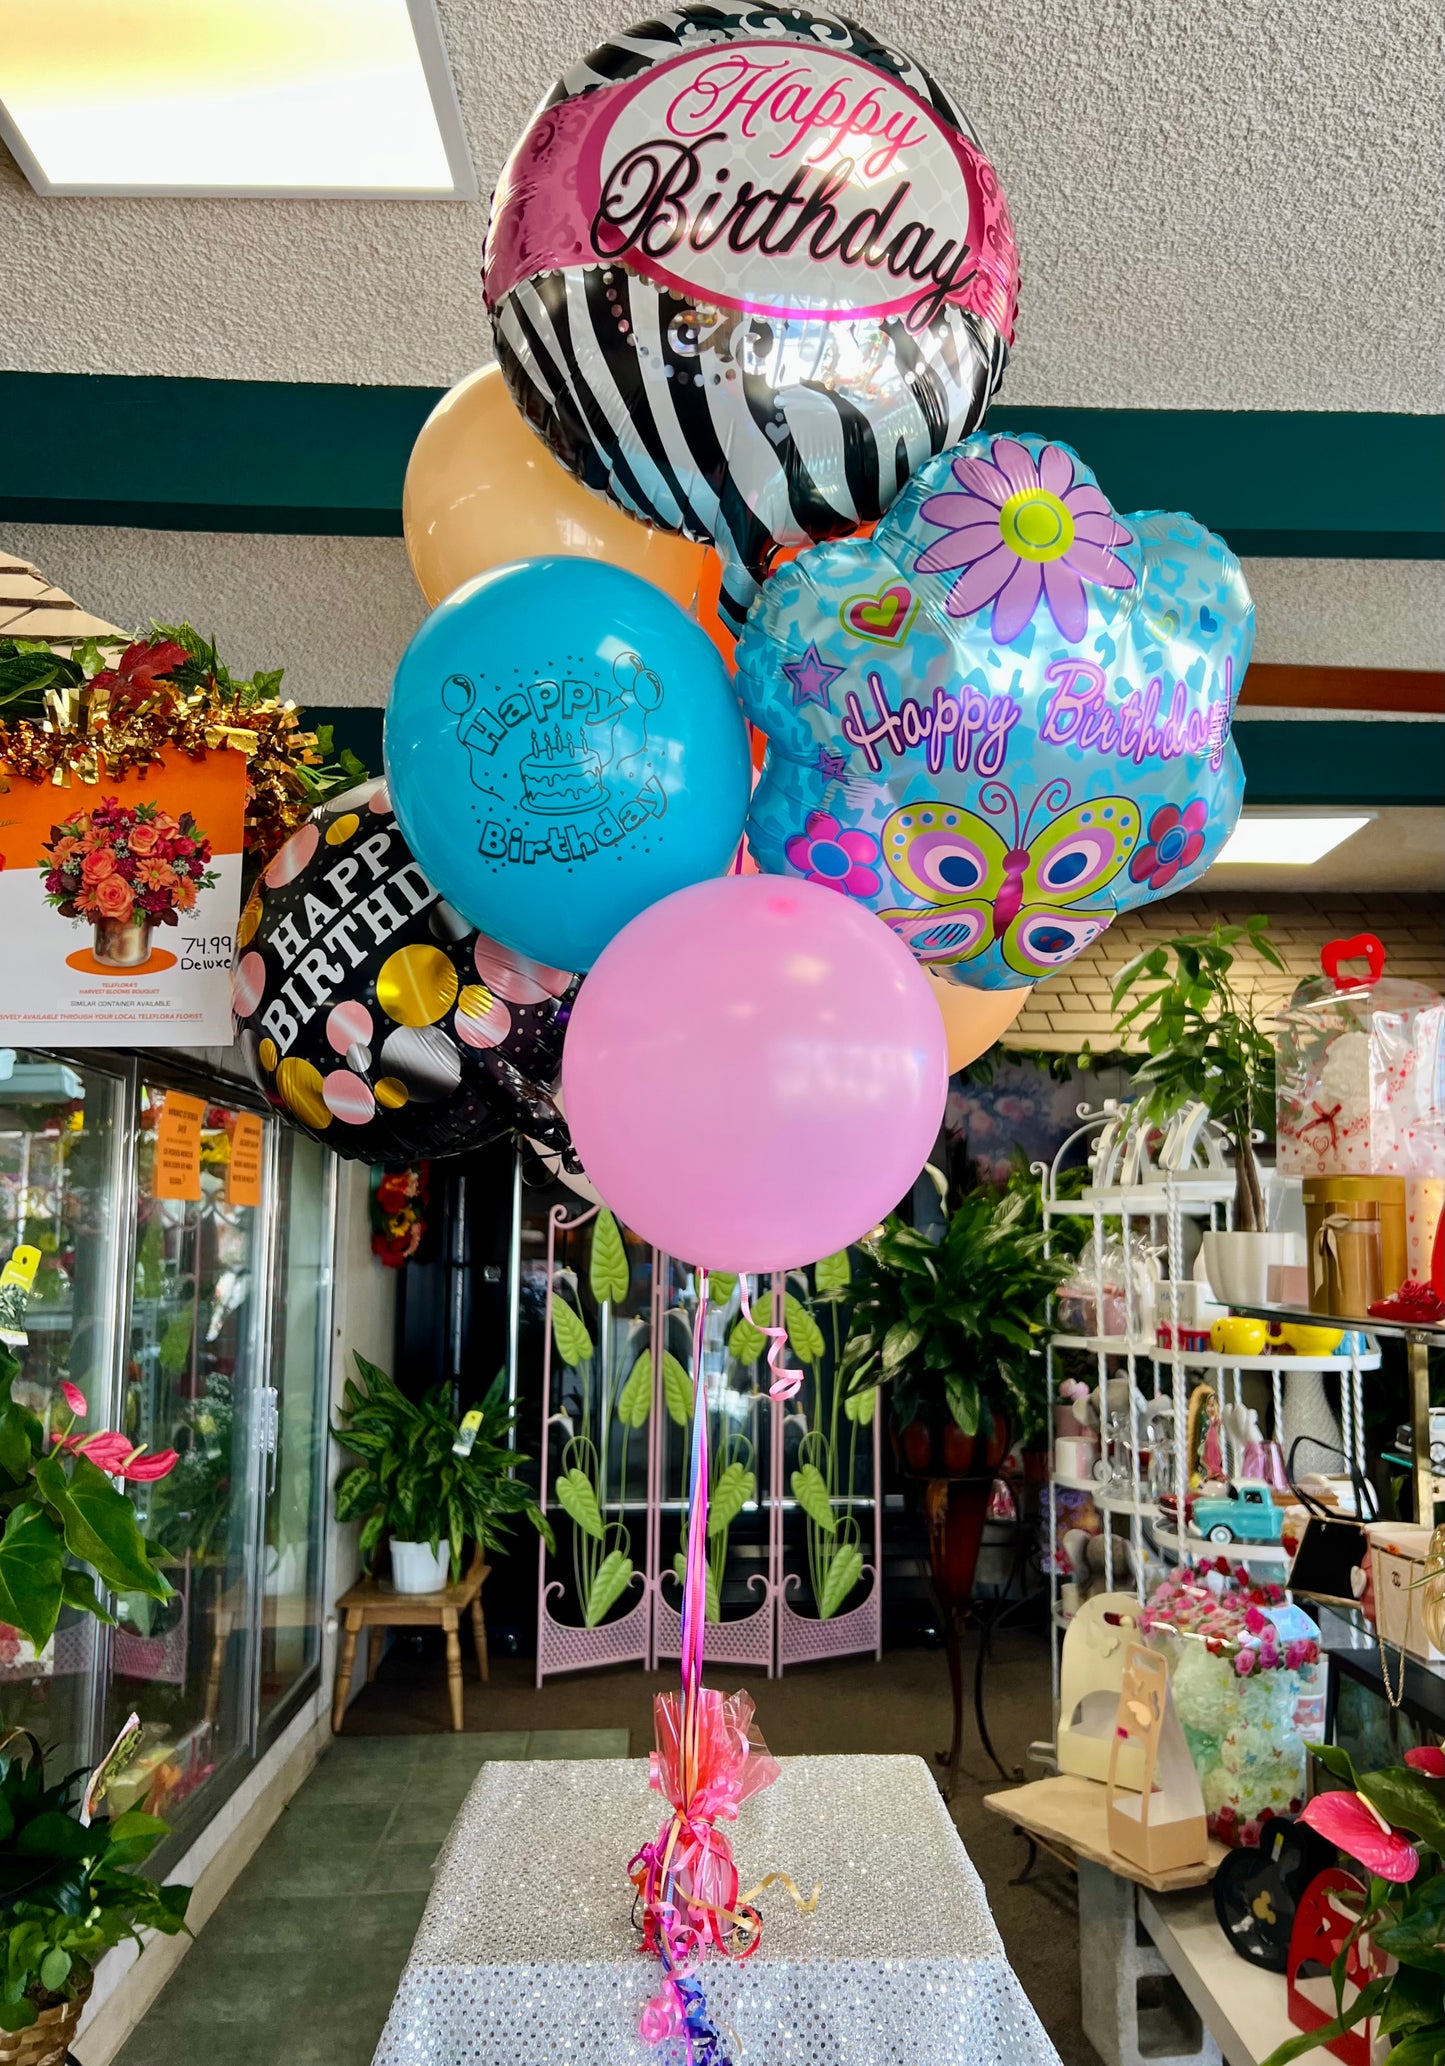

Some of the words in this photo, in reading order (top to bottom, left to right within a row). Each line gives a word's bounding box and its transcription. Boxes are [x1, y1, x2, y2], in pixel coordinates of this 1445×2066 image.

[665, 54, 928, 178] Happy
[590, 132, 979, 336] Birthday
[463, 679, 630, 756] Happy
[842, 671, 1022, 778] Happy
[478, 775, 668, 865] Birthday
[267, 820, 401, 970] HAPP
[180, 958, 232, 970] Deluxe
[181, 936, 232, 954] 74.99
